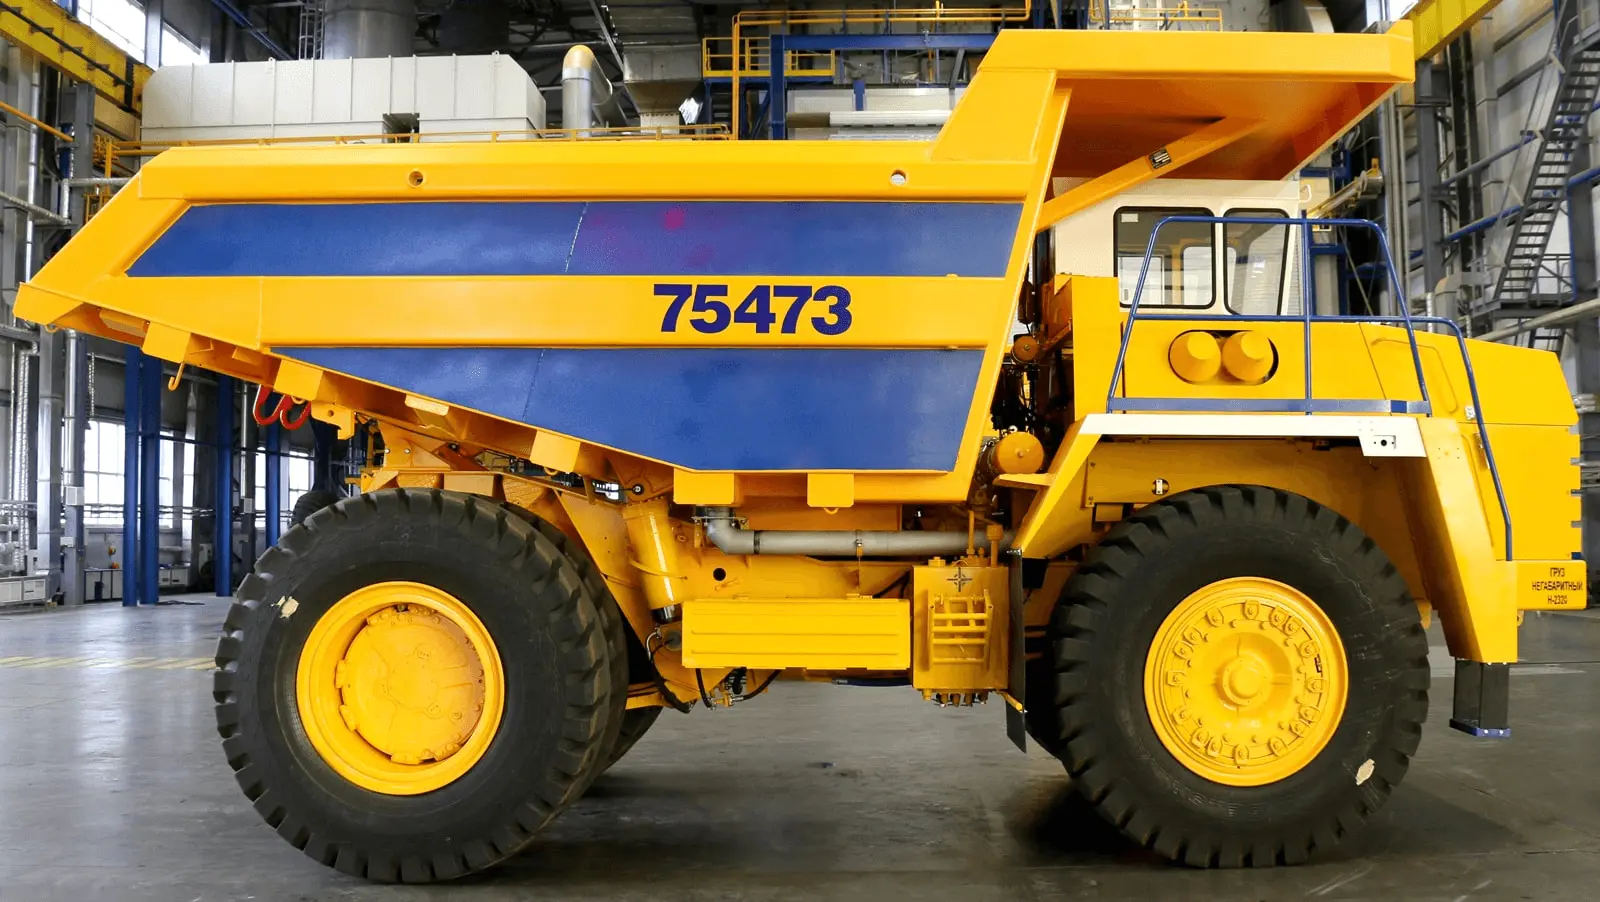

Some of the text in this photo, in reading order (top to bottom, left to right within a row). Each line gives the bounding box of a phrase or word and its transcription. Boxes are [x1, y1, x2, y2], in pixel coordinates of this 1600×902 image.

[653, 283, 853, 336] 75473
[1549, 567, 1566, 577] ГРУЗ
[1531, 580, 1583, 591] НЕГАБАРИТНЫЙ
